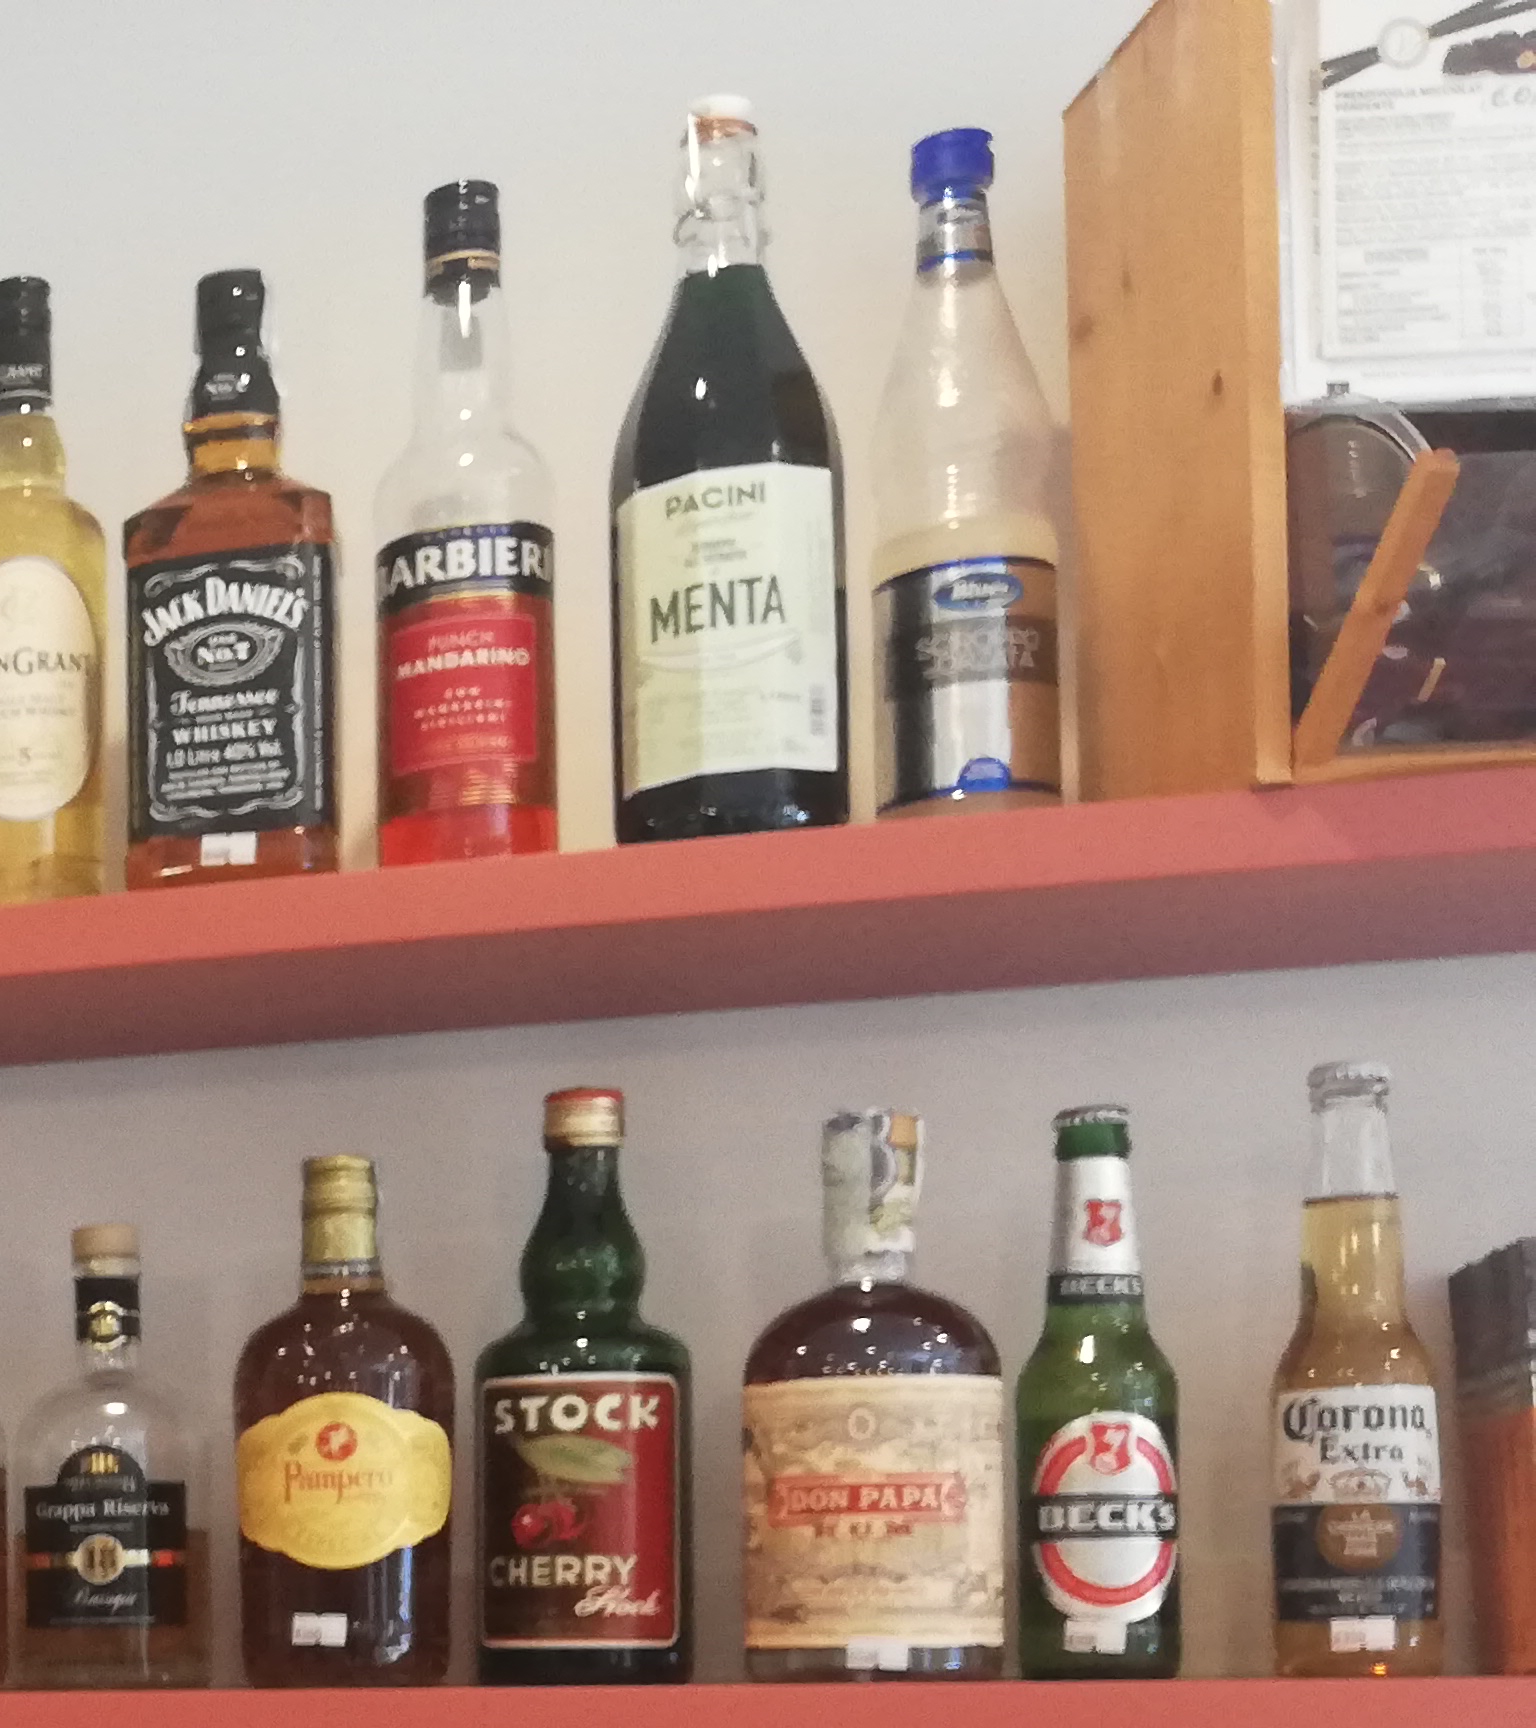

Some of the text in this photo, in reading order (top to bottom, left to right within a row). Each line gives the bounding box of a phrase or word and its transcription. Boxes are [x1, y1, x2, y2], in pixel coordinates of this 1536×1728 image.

[665, 481, 766, 519] PACINI
[142, 589, 204, 646] JACK
[650, 573, 786, 644] MENTA
[494, 1393, 660, 1435] STOCK
[1283, 1397, 1427, 1443] Corona
[1320, 1434, 1403, 1463] Extra
[490, 1554, 638, 1587] CHERRY
